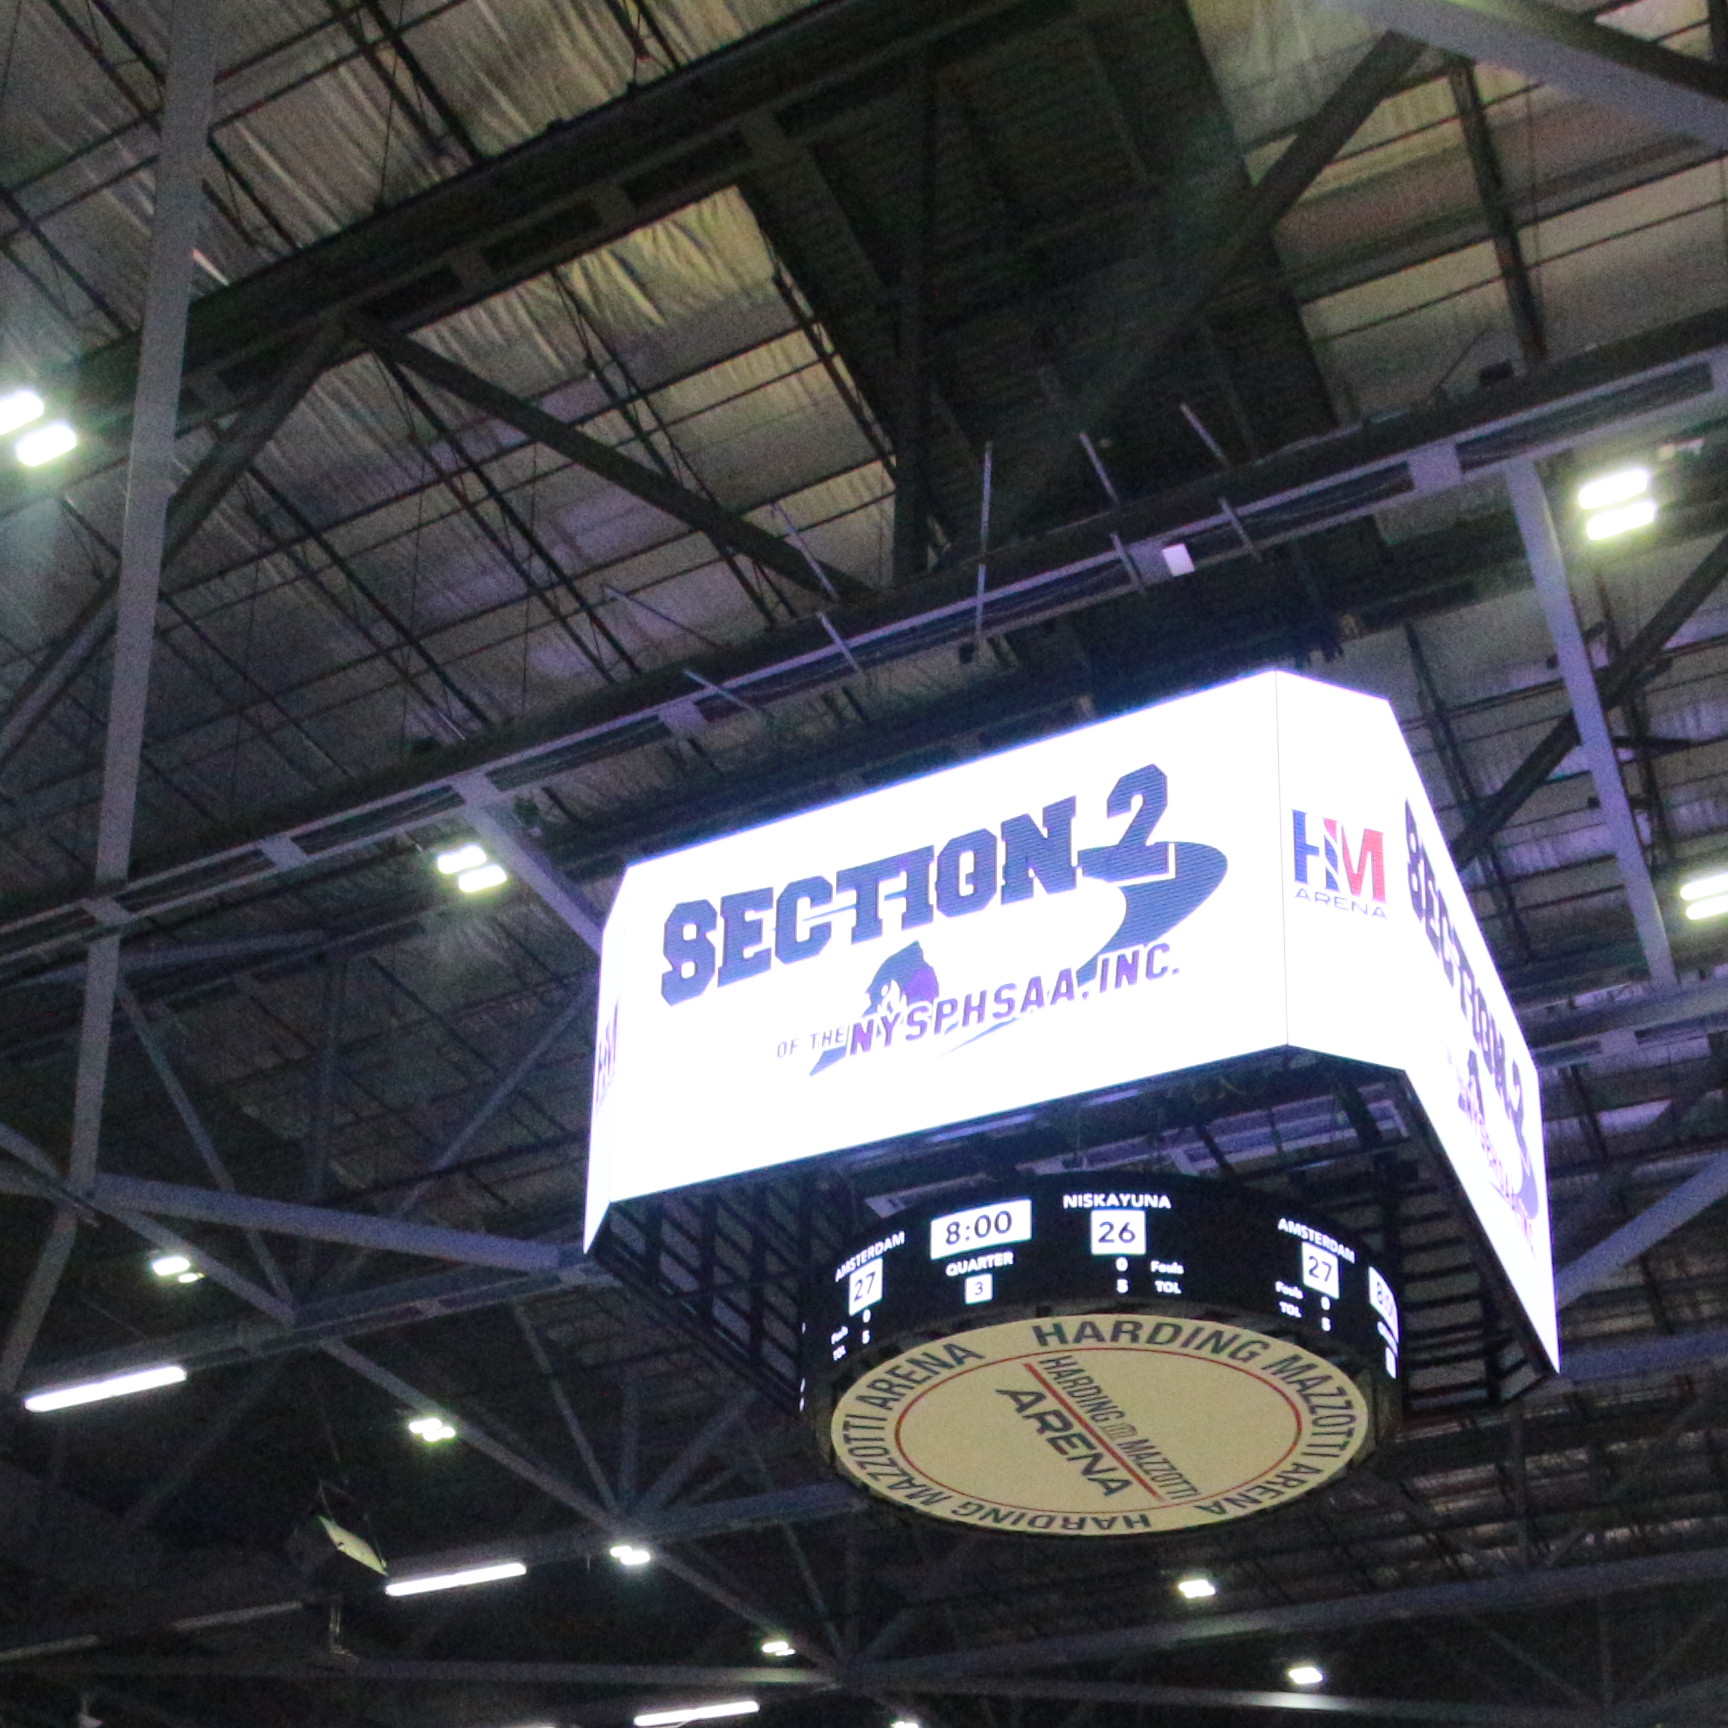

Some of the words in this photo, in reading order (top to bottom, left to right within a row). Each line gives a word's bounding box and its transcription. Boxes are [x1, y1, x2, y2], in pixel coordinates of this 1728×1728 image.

[661, 793, 1081, 1007] SECTION
[1098, 763, 1171, 884] 2
[1293, 887, 1388, 921] ARENA
[776, 1039, 800, 1058] OF
[809, 1026, 845, 1051] THE
[1099, 942, 1181, 993] INC.
[1062, 1192, 1172, 1210] NISKAYUNA
[944, 1211, 1014, 1247] 8:00
[1097, 1221, 1137, 1245] 26
[1276, 1217, 1356, 1265] AMSTERDAM
[834, 1231, 906, 1283] AMSTERDAM
[945, 1251, 1014, 1277] QUARTER
[1115, 1256, 1129, 1272] 0
[1150, 1260, 1185, 1275] Fouls
[1308, 1255, 1333, 1283] 27
[853, 1271, 877, 1303] 27
[974, 1281, 984, 1297] 3
[1116, 1278, 1129, 1294] 5
[1154, 1280, 1182, 1295] TOL
[861, 1308, 872, 1324] 0
[1279, 1301, 1302, 1318] TOL
[1030, 1319, 1270, 1363] HARDING
[855, 1342, 986, 1412] ARENA
[1260, 1353, 1357, 1458] MAZZOTTI
[994, 1388, 1134, 1497] ARENA
[1038, 1354, 1126, 1424] HARDING
[1116, 1437, 1202, 1500] MAZZOTTI
[842, 1413, 952, 1506] MAZZOTTI
[1194, 1461, 1324, 1516] ARENA
[950, 1500, 1153, 1532] HARDING
